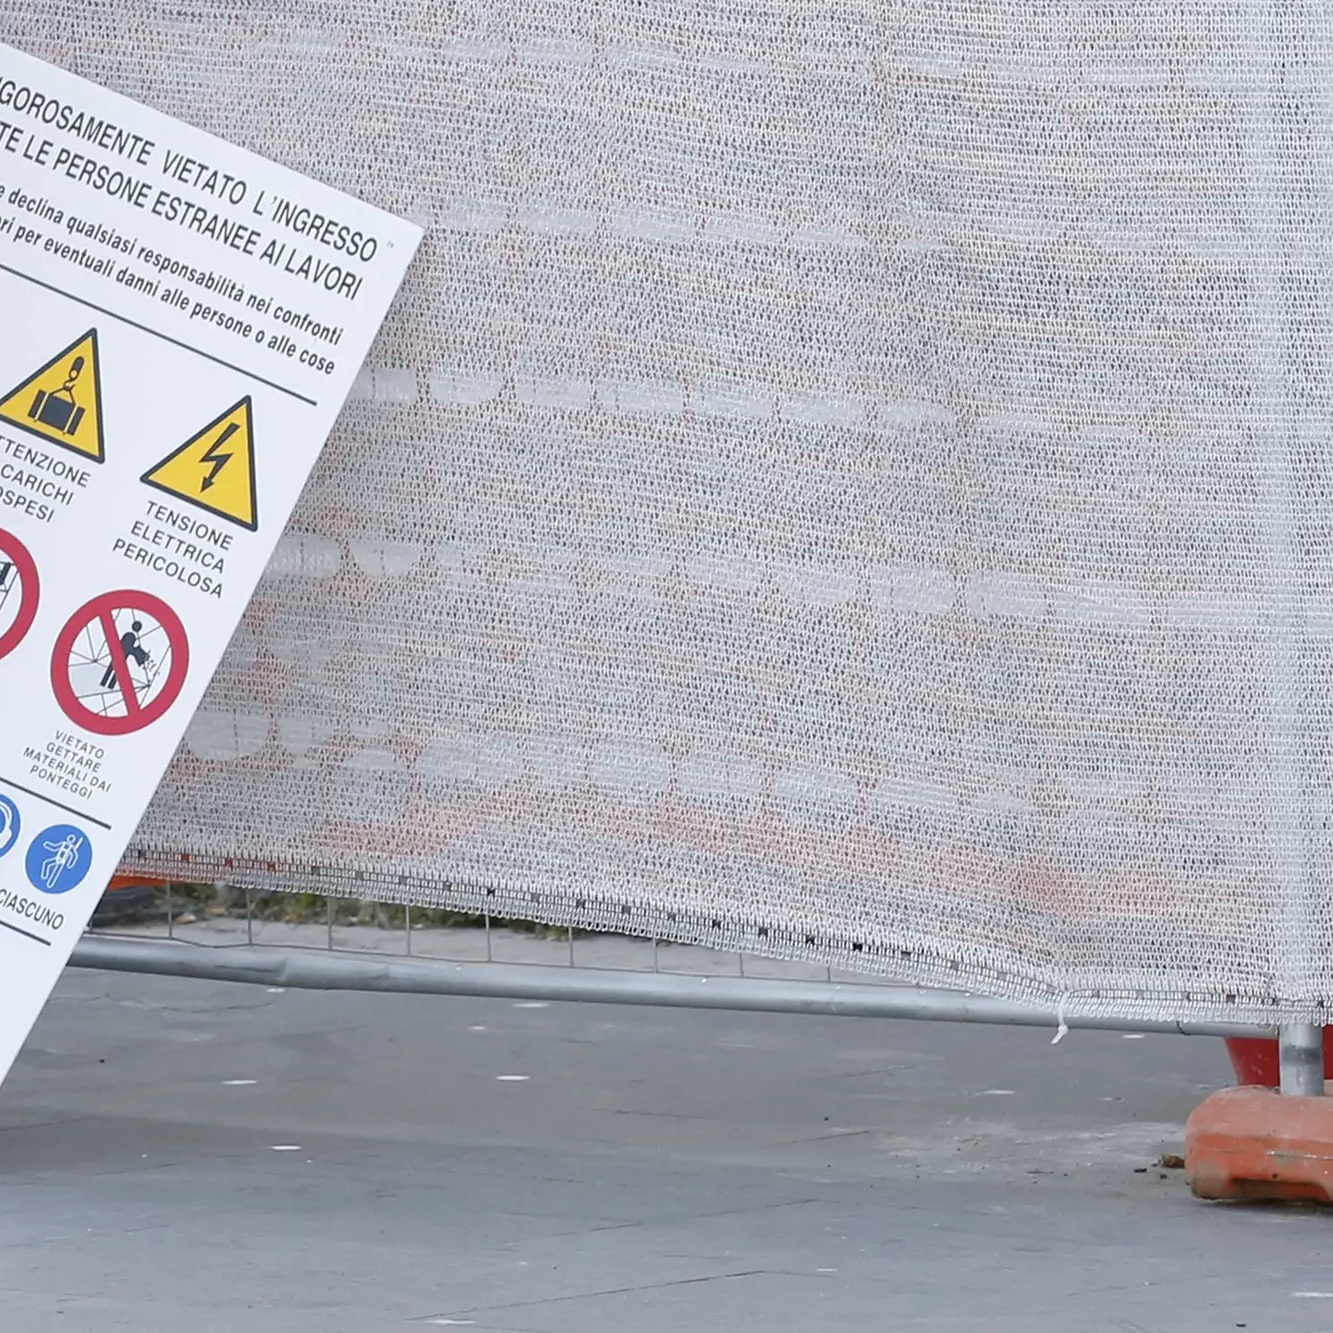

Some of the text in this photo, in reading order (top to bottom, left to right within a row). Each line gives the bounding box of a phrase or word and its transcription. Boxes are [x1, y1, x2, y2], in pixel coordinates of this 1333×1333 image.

[162, 149, 246, 204] VIETATO
[22, 134, 53, 165] LE
[52, 147, 152, 208] PERSONE
[151, 190, 261, 255] ESTRANEE
[259, 239, 285, 265] AI
[284, 248, 362, 299] LAVORI
[8, 188, 63, 224] declina
[66, 216, 137, 254] qualsiasi
[137, 247, 244, 302] responsabilità
[246, 294, 273, 313] nei
[273, 306, 343, 345] confronti
[12, 225, 42, 245] per
[43, 238, 115, 277] eventuali
[115, 267, 160, 296] danni
[160, 288, 189, 310] alle
[189, 302, 252, 337] persone
[255, 330, 264, 343] o
[267, 335, 296, 357] alle
[299, 349, 334, 374] cose
[0, 463, 73, 505] CARICHI
[130, 520, 223, 573] ELETTRICA
[146, 500, 233, 550] TENSIONE
[112, 538, 221, 598] PERICOLOSA
[23, 746, 111, 792] MATERIALI DAI
[46, 742, 100, 772] GETTARE
[55, 730, 104, 759] VIETATO
[29, 764, 92, 799] PONTEGGI
